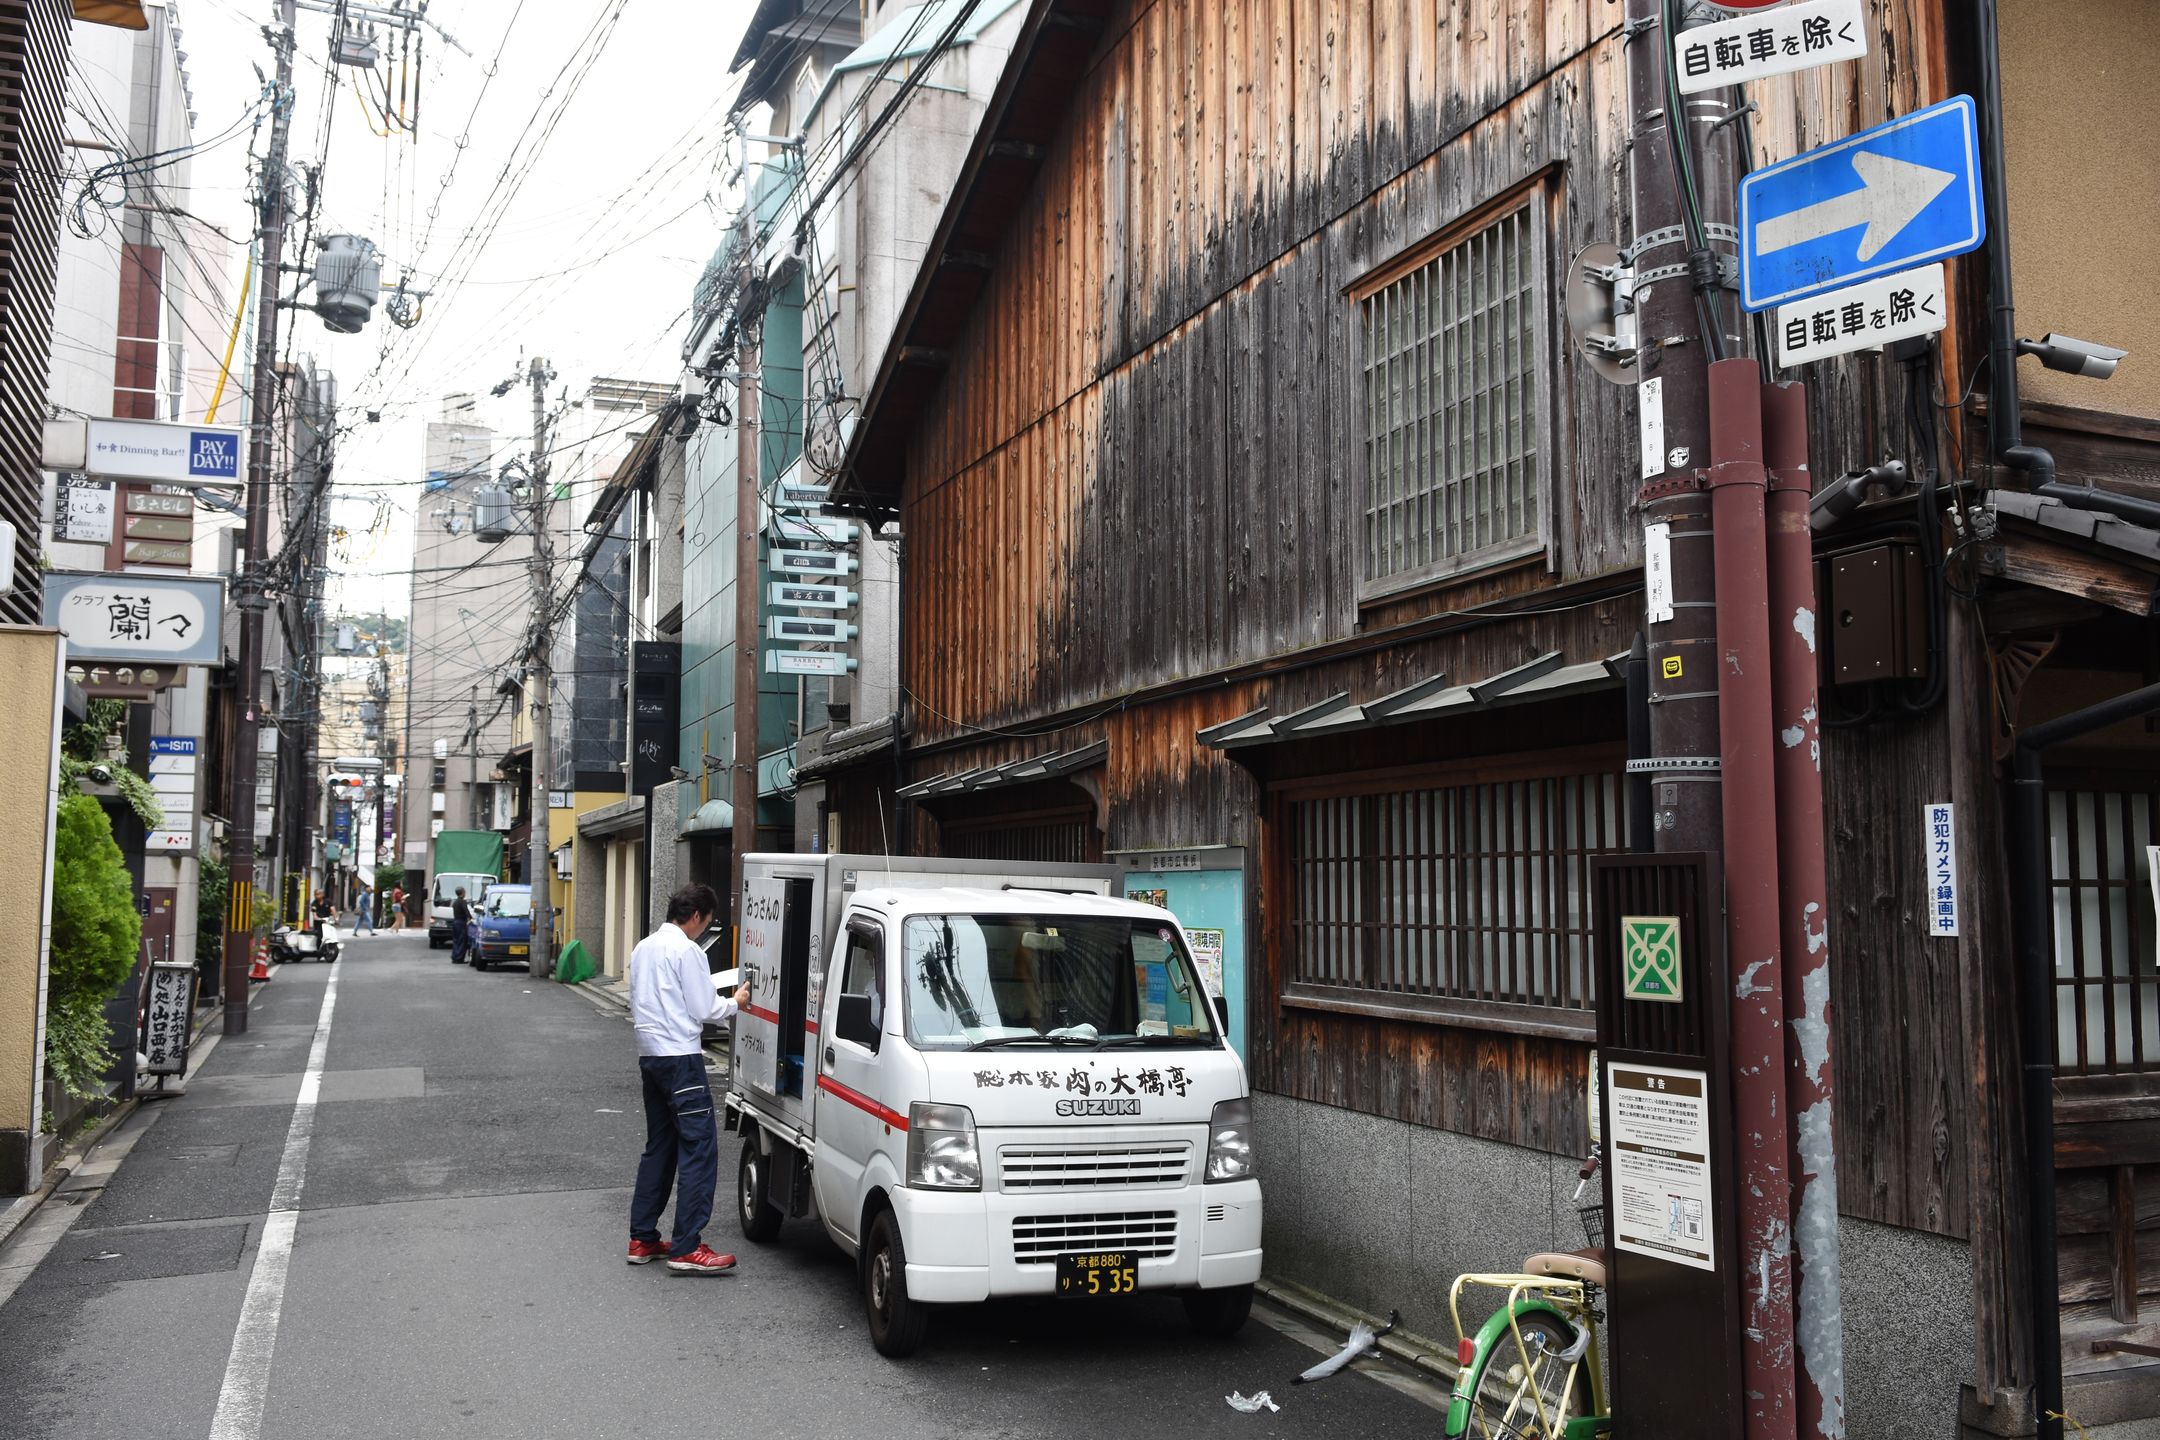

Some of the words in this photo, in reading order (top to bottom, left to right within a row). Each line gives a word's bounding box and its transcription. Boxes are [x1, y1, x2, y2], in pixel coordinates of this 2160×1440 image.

[1684, 15, 1856, 77] 自転車を除く
[1785, 288, 1937, 351] 自転車を除く
[120, 444, 159, 456] Dinning
[199, 439, 227, 455] PAY
[193, 453, 234, 470] DAY!!
[1933, 808, 1954, 931] 防犯カメラ録画中
[746, 894, 780, 922] おっさんの
[745, 929, 765, 949] おいしい
[1056, 1098, 1141, 1116] SUZUKI
